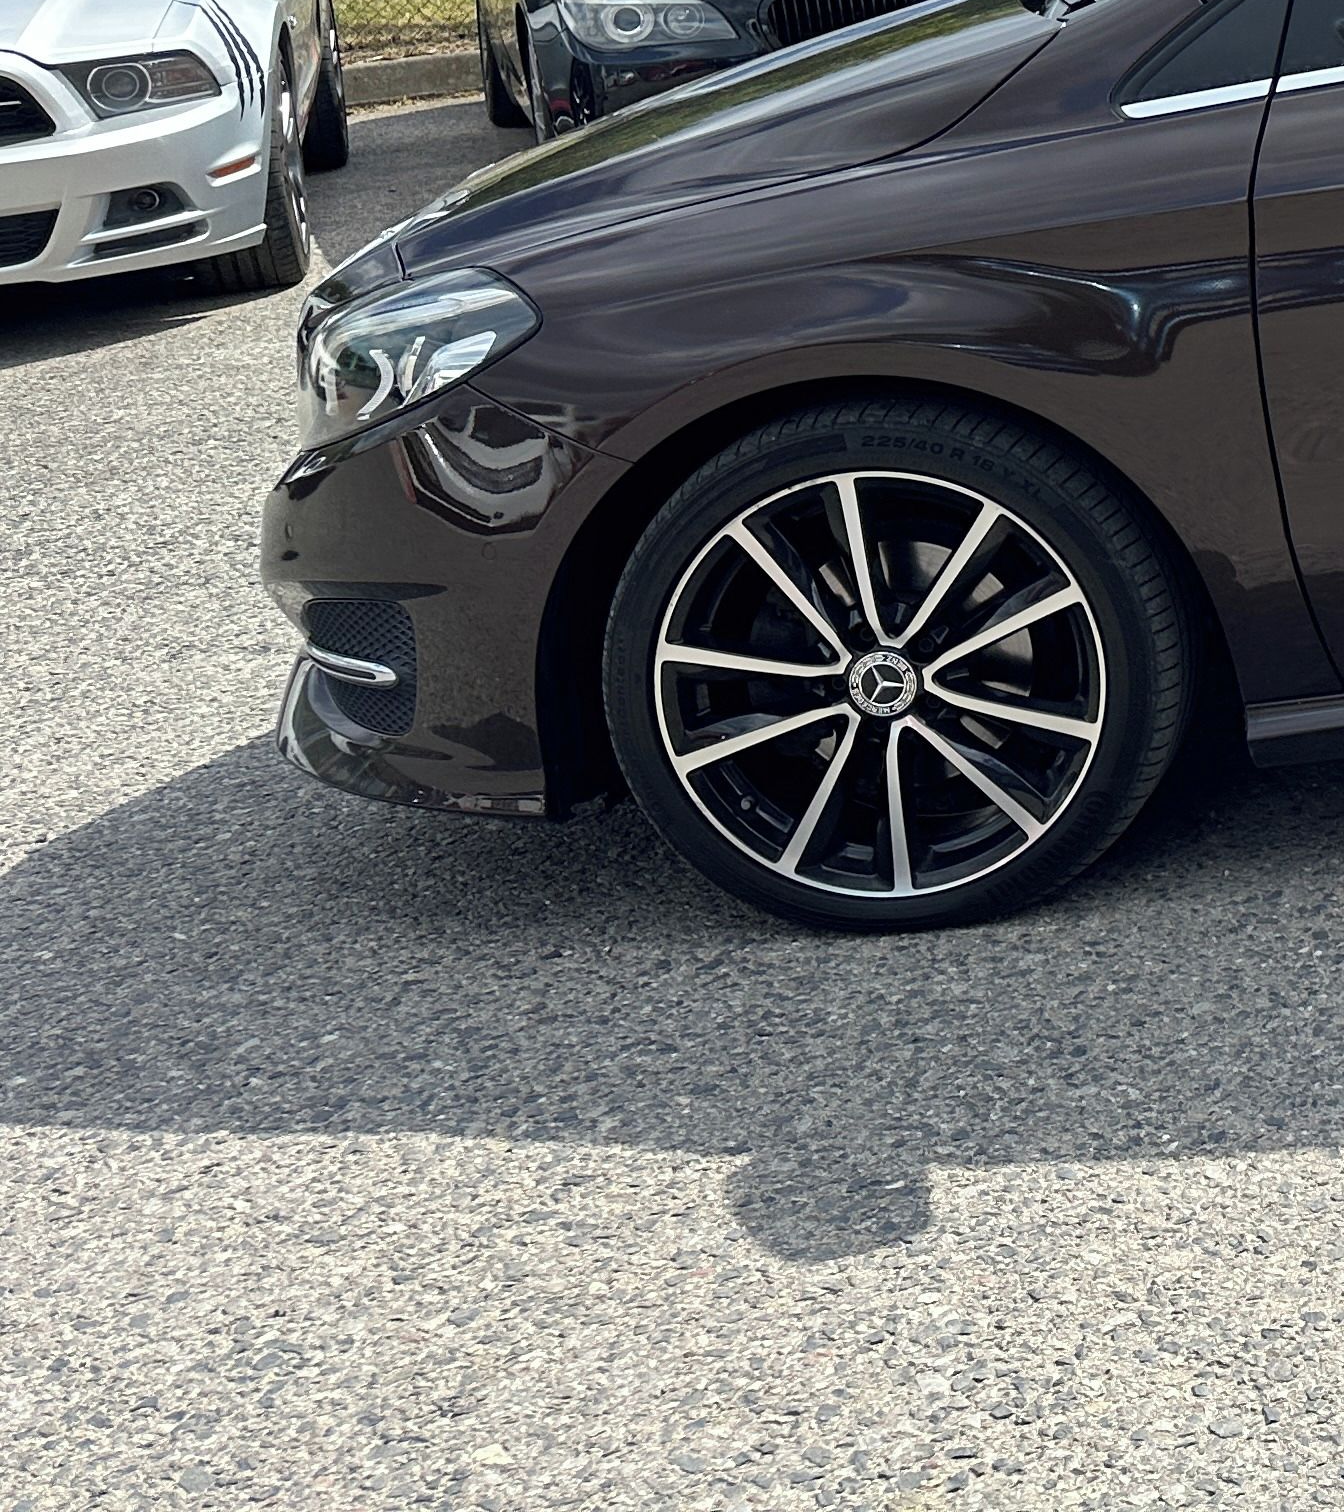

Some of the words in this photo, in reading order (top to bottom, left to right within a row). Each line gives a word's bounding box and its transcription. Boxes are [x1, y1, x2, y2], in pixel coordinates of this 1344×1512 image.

[861, 435, 944, 455] 225/40
[950, 448, 965, 461] R
[972, 455, 996, 472] 18
